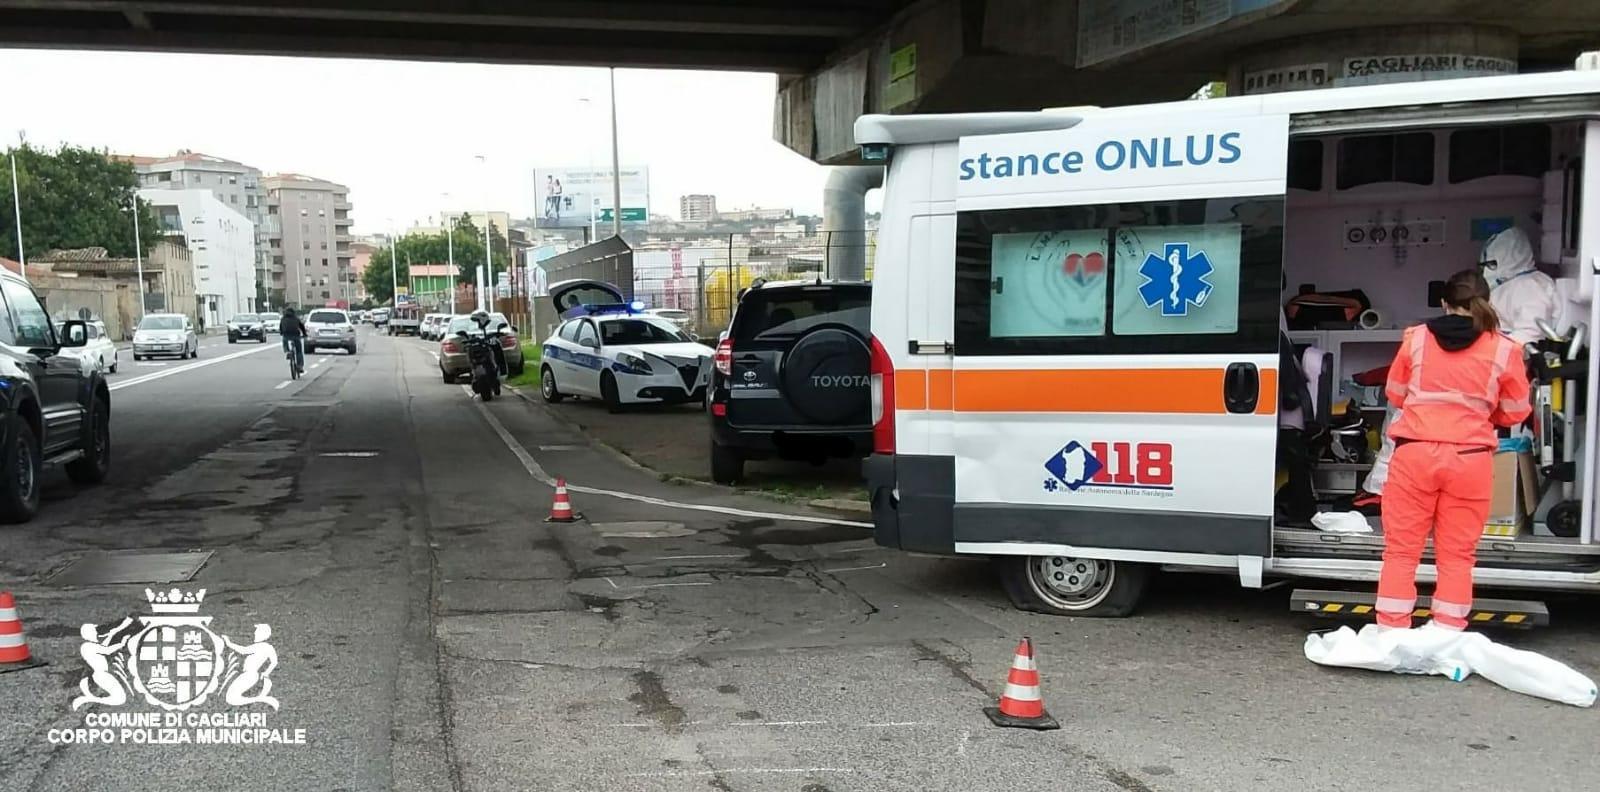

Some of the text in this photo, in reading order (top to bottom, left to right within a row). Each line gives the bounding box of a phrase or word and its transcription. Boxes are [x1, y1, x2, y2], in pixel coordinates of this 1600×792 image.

[1348, 56, 1457, 72] CAGLIARI
[958, 132, 1242, 181] stance ONLUS
[810, 375, 870, 388] TOYOTA
[1091, 442, 1173, 485] 118
